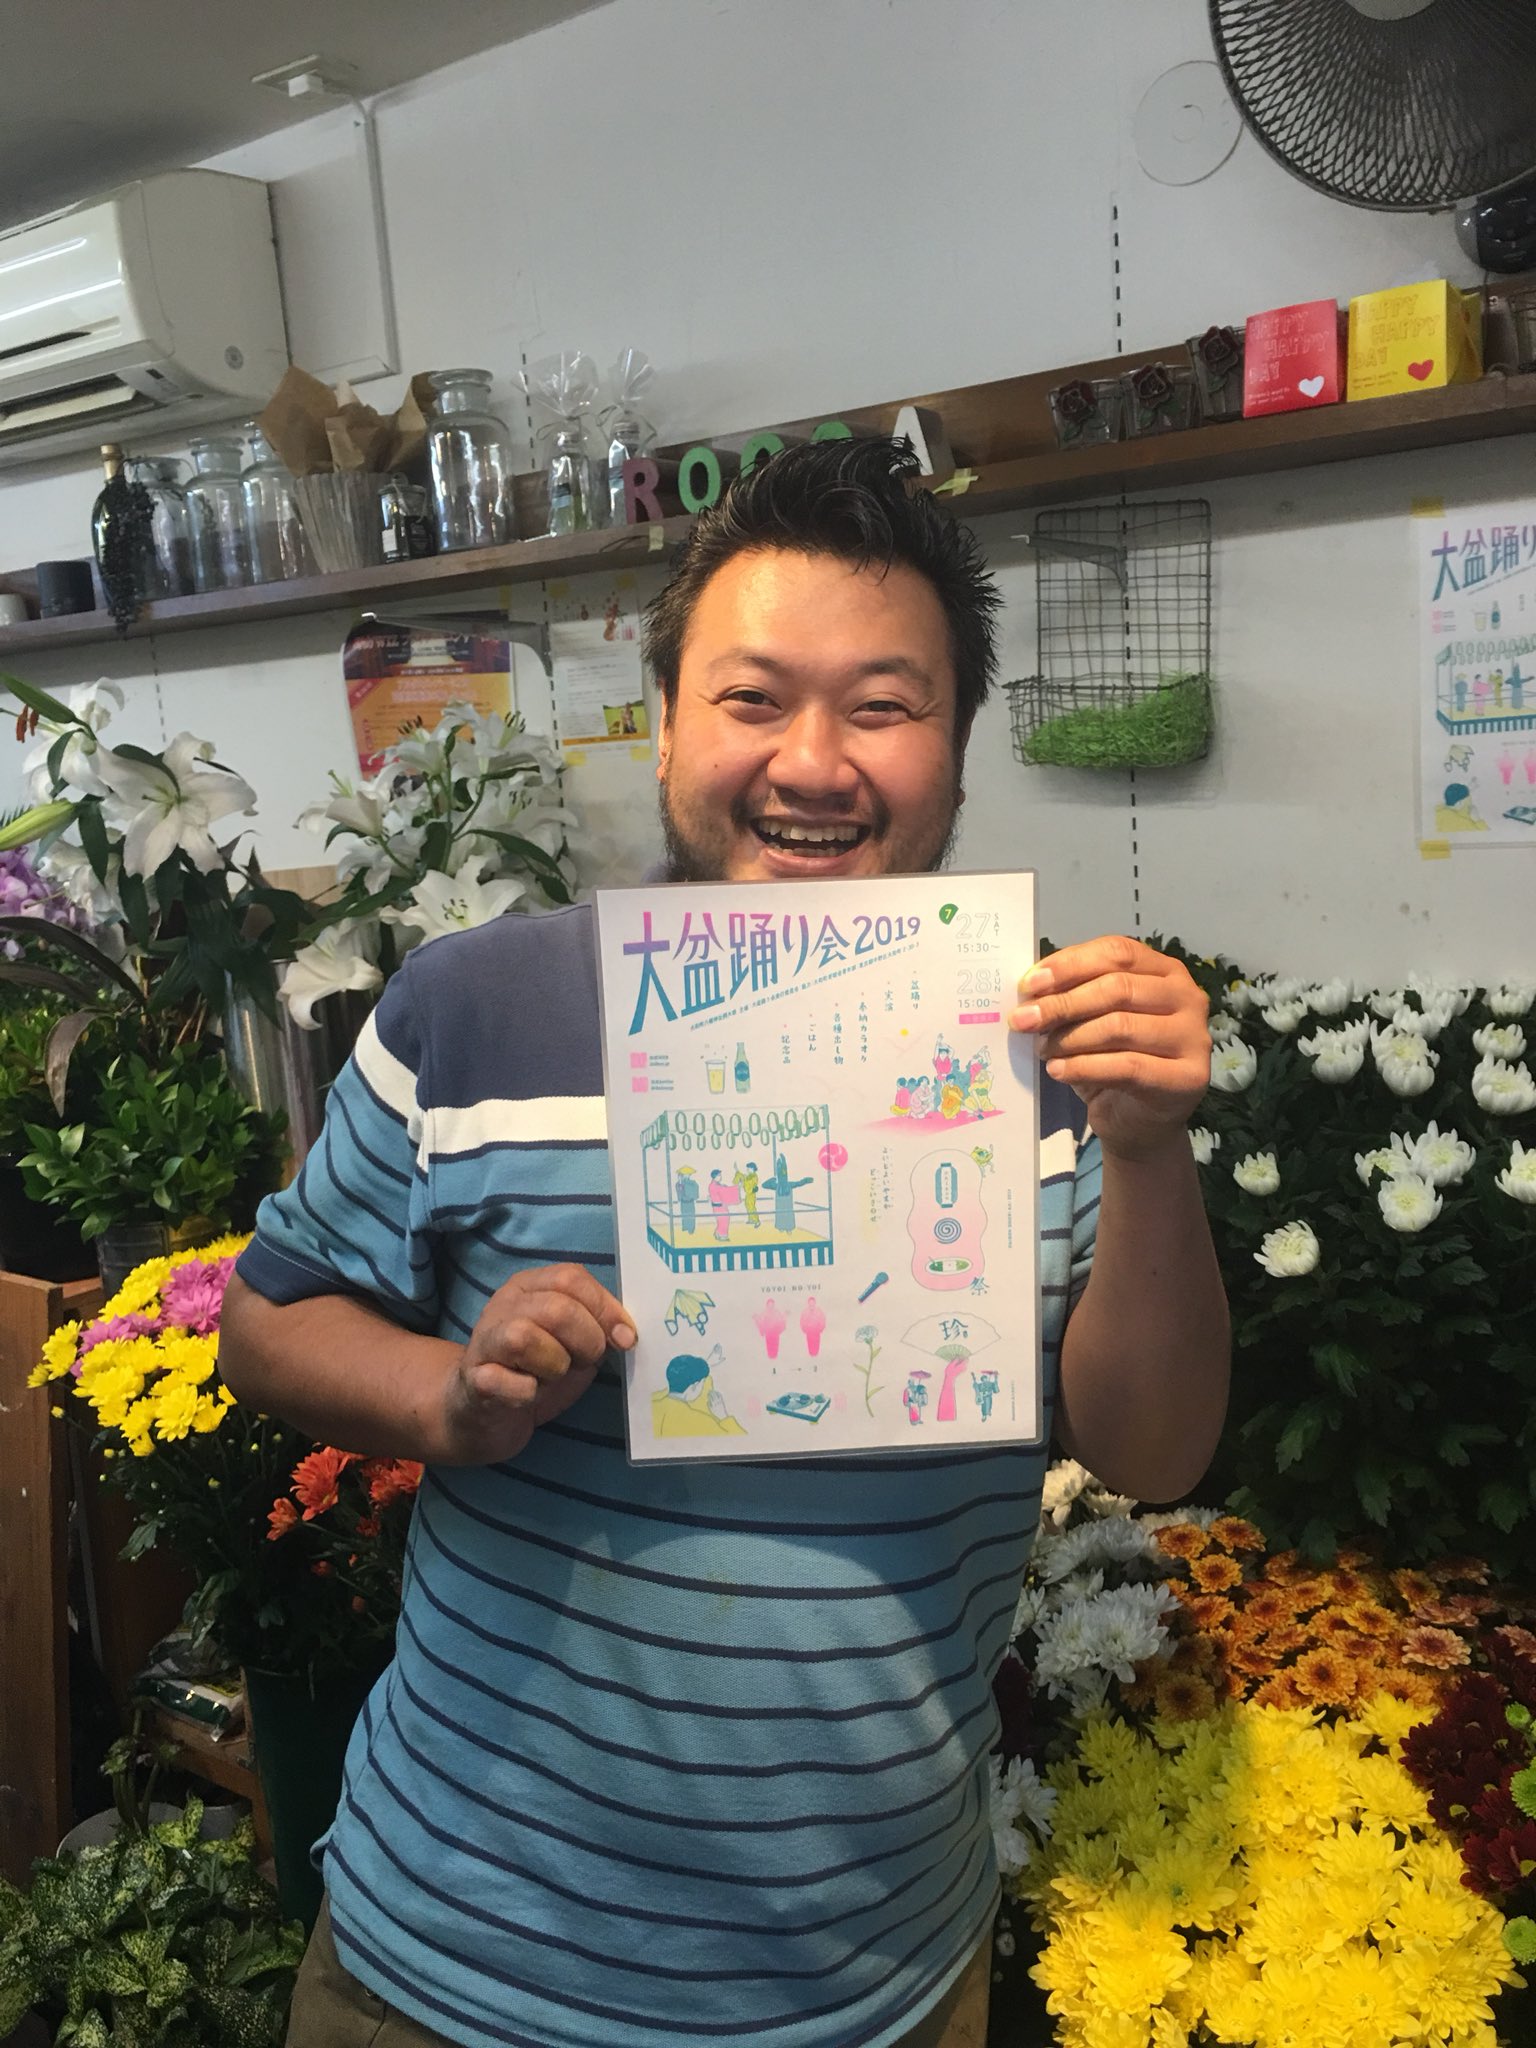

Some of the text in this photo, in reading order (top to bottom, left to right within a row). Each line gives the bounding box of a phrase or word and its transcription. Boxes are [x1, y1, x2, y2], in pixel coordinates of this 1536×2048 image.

[1371, 314, 1442, 347] HAPPY
[944, 908, 953, 920] 7
[955, 912, 991, 939] 27
[623, 911, 921, 1036] 大盆踊り会2019
[956, 968, 992, 995] 28
[911, 980, 920, 1010] 盆踊り
[808, 1023, 817, 1052] ごはん
